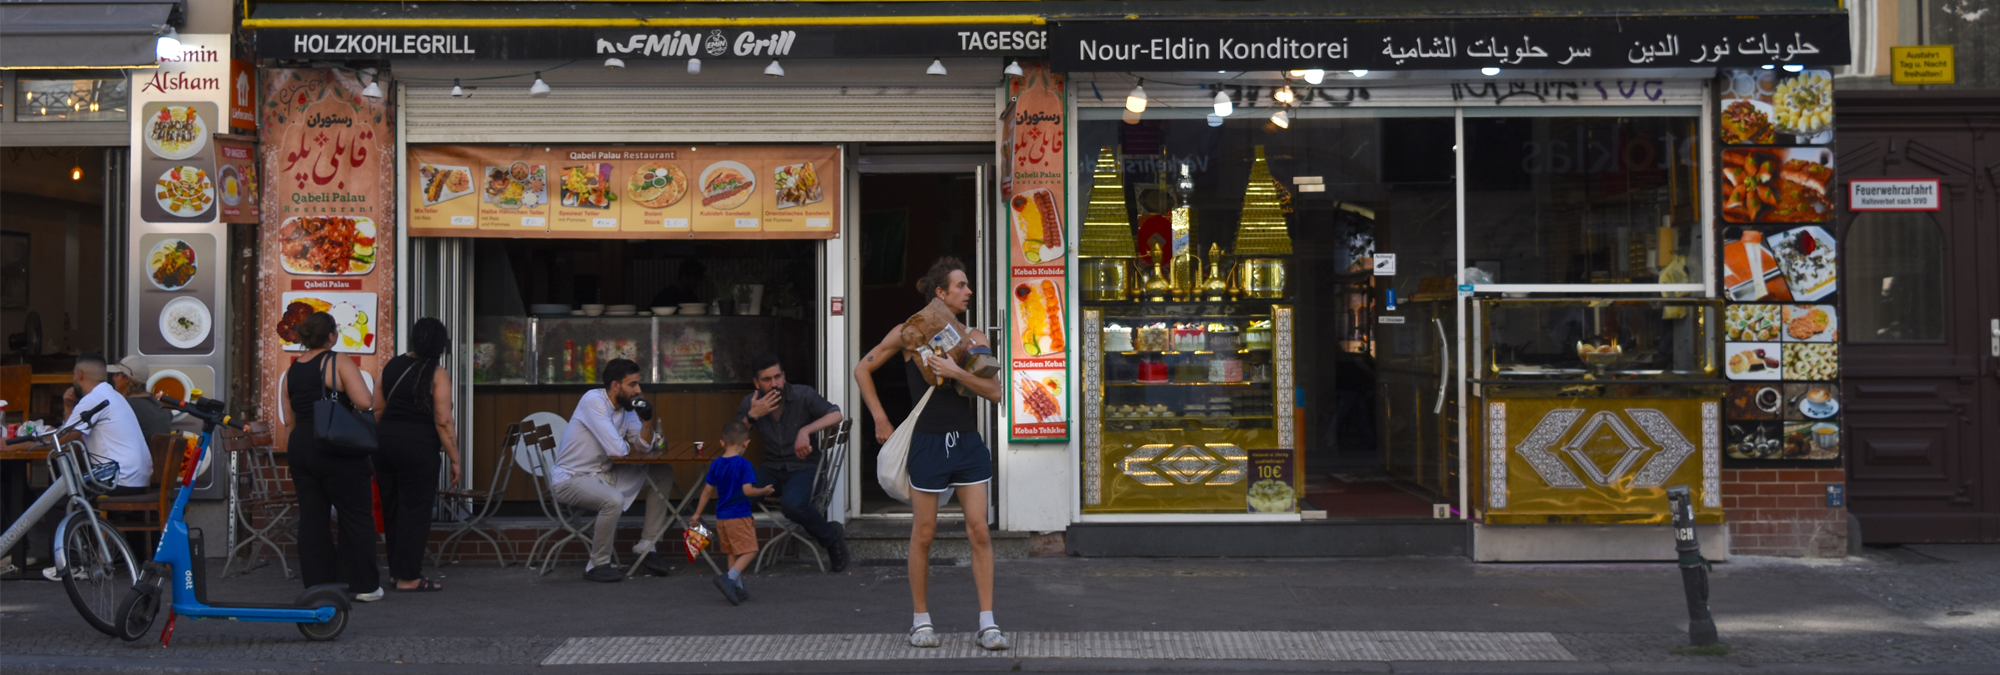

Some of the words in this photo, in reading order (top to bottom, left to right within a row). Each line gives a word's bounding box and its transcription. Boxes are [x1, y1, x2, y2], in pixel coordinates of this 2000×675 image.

[294, 34, 475, 54] HOLZKOHLEGRILL
[733, 30, 796, 56] Grill
[1080, 38, 1210, 60] Nour-Eldin
[1219, 36, 1348, 59] Konditorei
[1382, 36, 1457, 66] الشامية
[1466, 35, 1548, 65] حلويات
[1628, 34, 1680, 64] الدين
[1690, 36, 1730, 63] نور
[1737, 32, 1820, 62] حلويات
[1557, 45, 1592, 65] سر
[141, 70, 220, 94] Alsham
[307, 112, 353, 128] رستوران
[1016, 110, 1060, 125] رستوران
[570, 152, 597, 160] Qabeli
[291, 192, 330, 204] Qabeli
[332, 192, 366, 202] Palau
[1855, 184, 1932, 195] Feuerwehrzufahrt
[1258, 465, 1282, 478] 10€
[185, 570, 193, 590] dott
